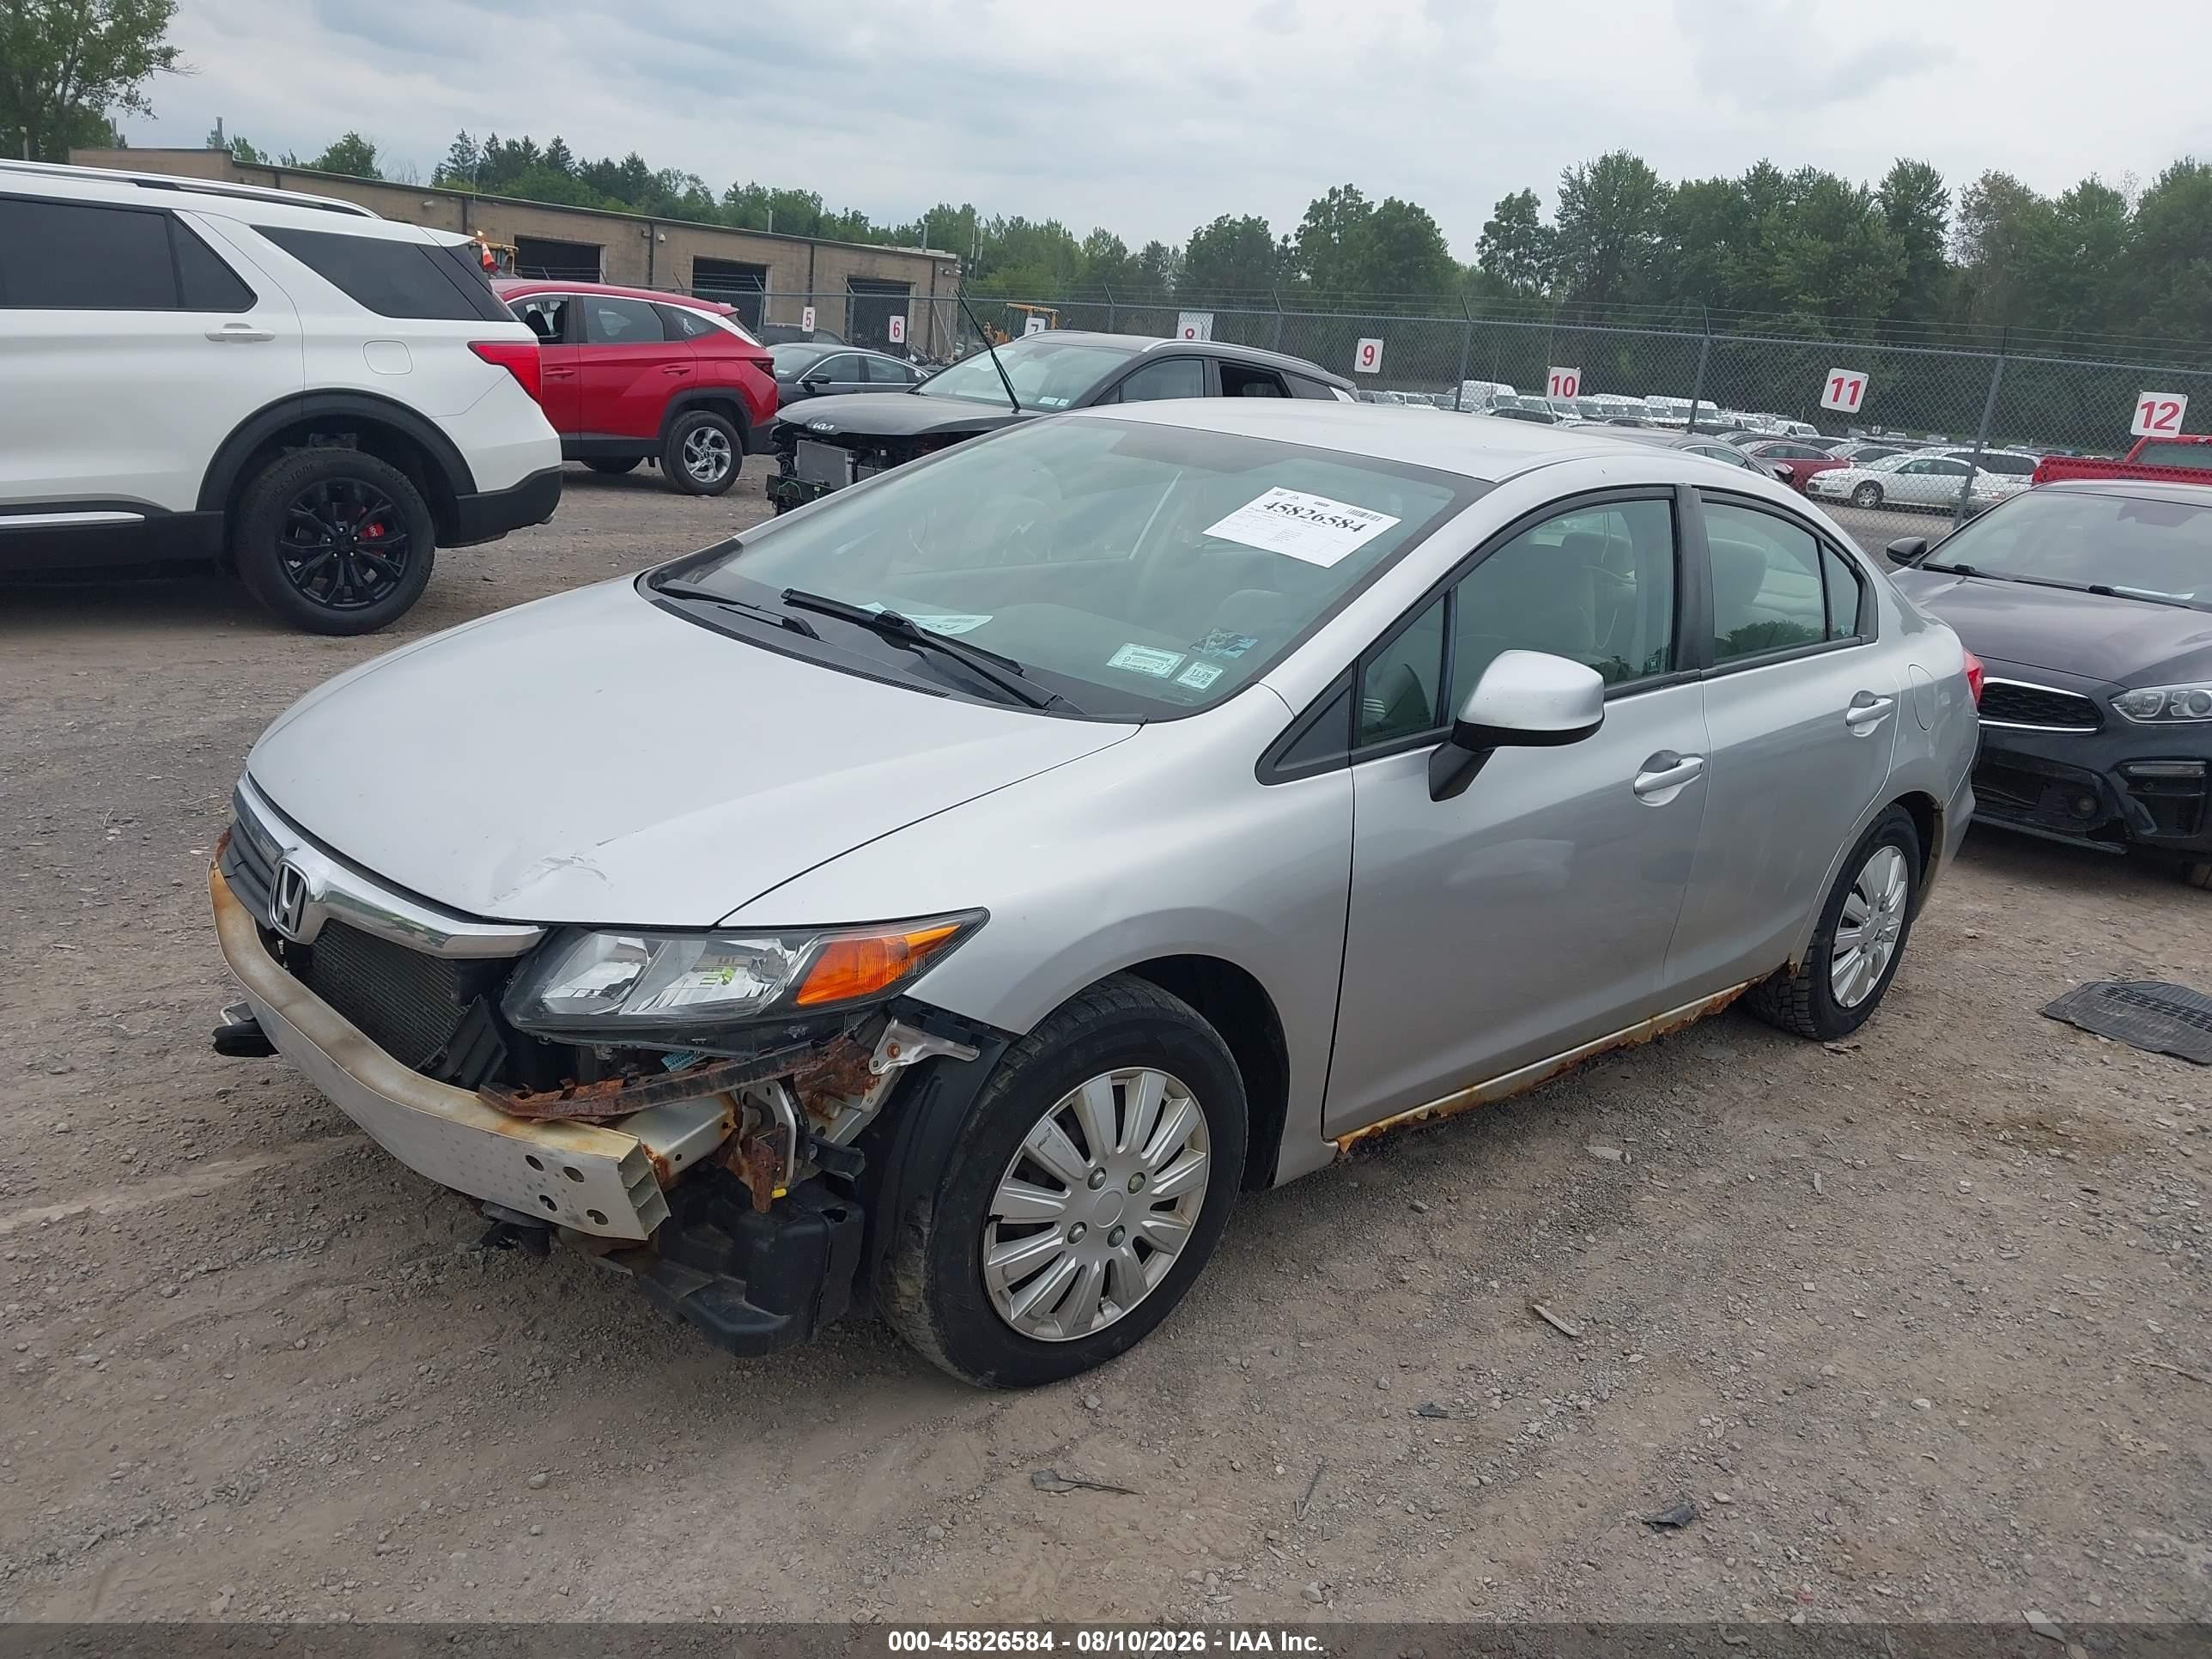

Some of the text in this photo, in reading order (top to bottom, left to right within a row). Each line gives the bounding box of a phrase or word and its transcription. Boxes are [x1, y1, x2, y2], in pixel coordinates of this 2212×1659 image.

[805, 312, 811, 327] 5
[893, 321, 901, 338] 6
[1362, 345, 1375, 367] 9
[1551, 375, 1577, 398] 10
[1832, 377, 1862, 405] 11
[2141, 401, 2180, 430] 12
[1263, 501, 1368, 532] 45826584
